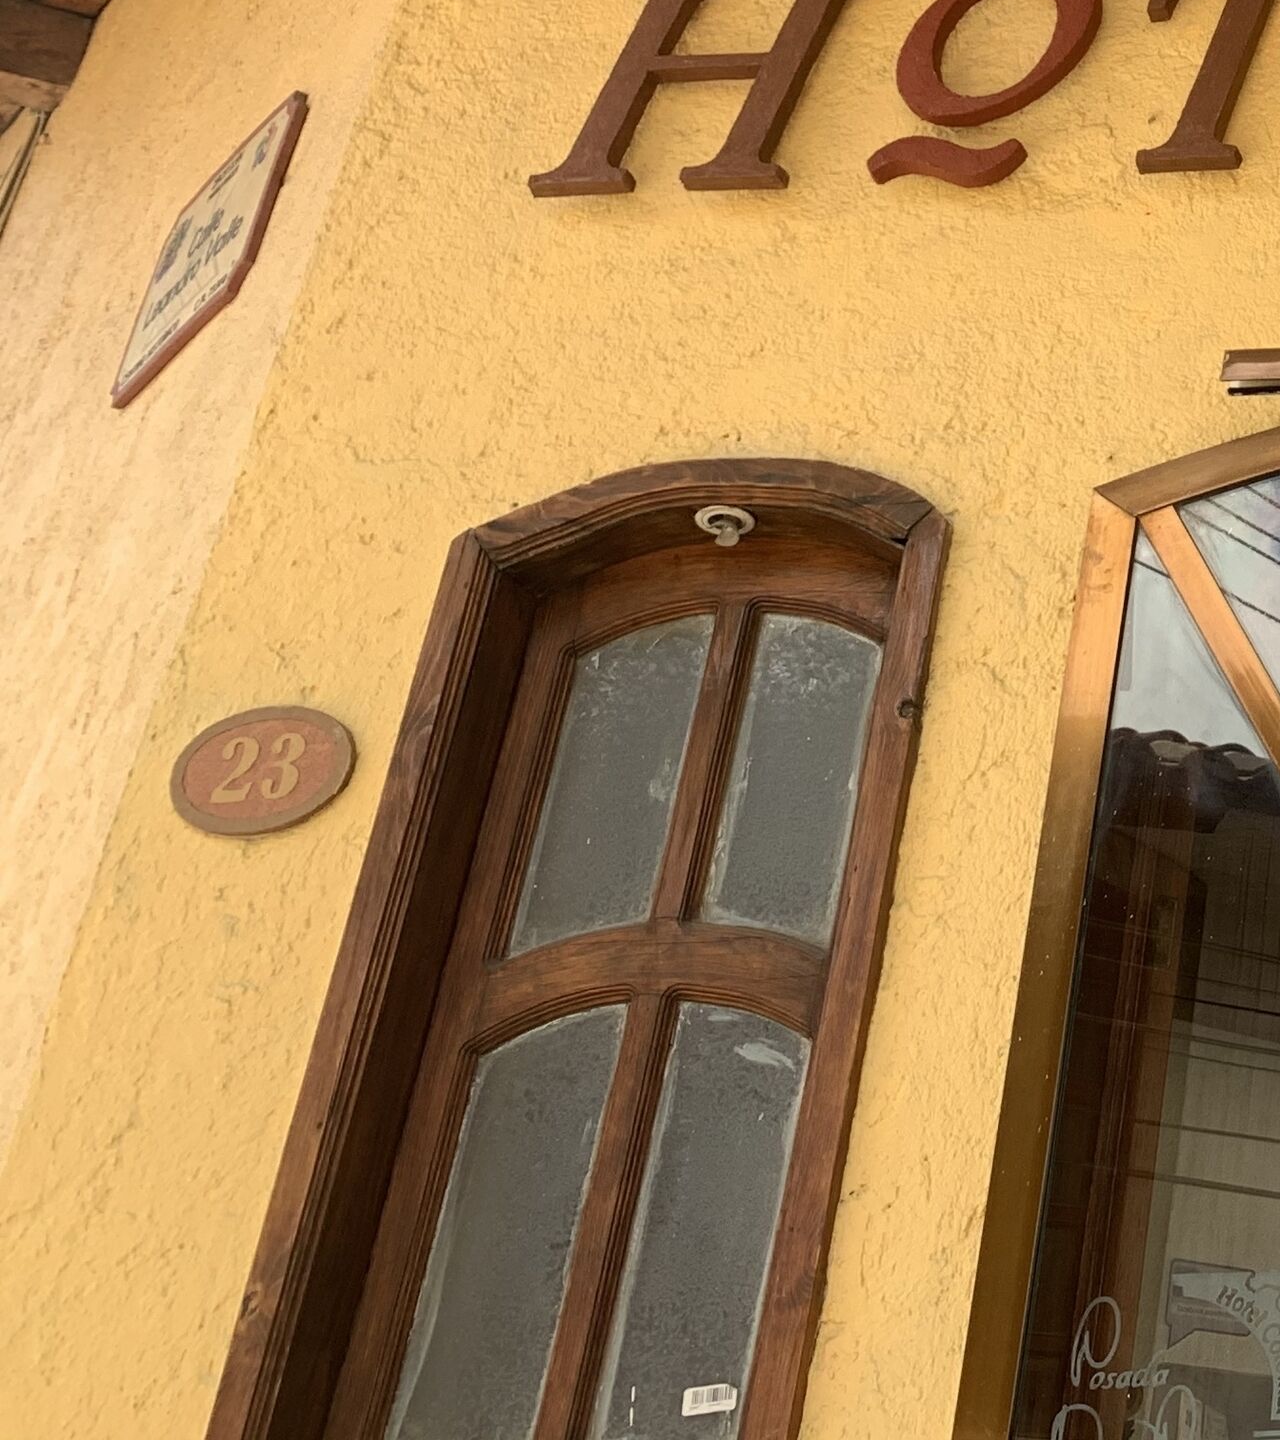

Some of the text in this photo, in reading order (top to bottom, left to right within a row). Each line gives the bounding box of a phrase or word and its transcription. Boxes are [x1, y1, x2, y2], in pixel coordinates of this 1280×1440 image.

[210, 732, 306, 804] 23
[1070, 1295, 1171, 1390] Posada
[1216, 1285, 1269, 1329] Hotel
